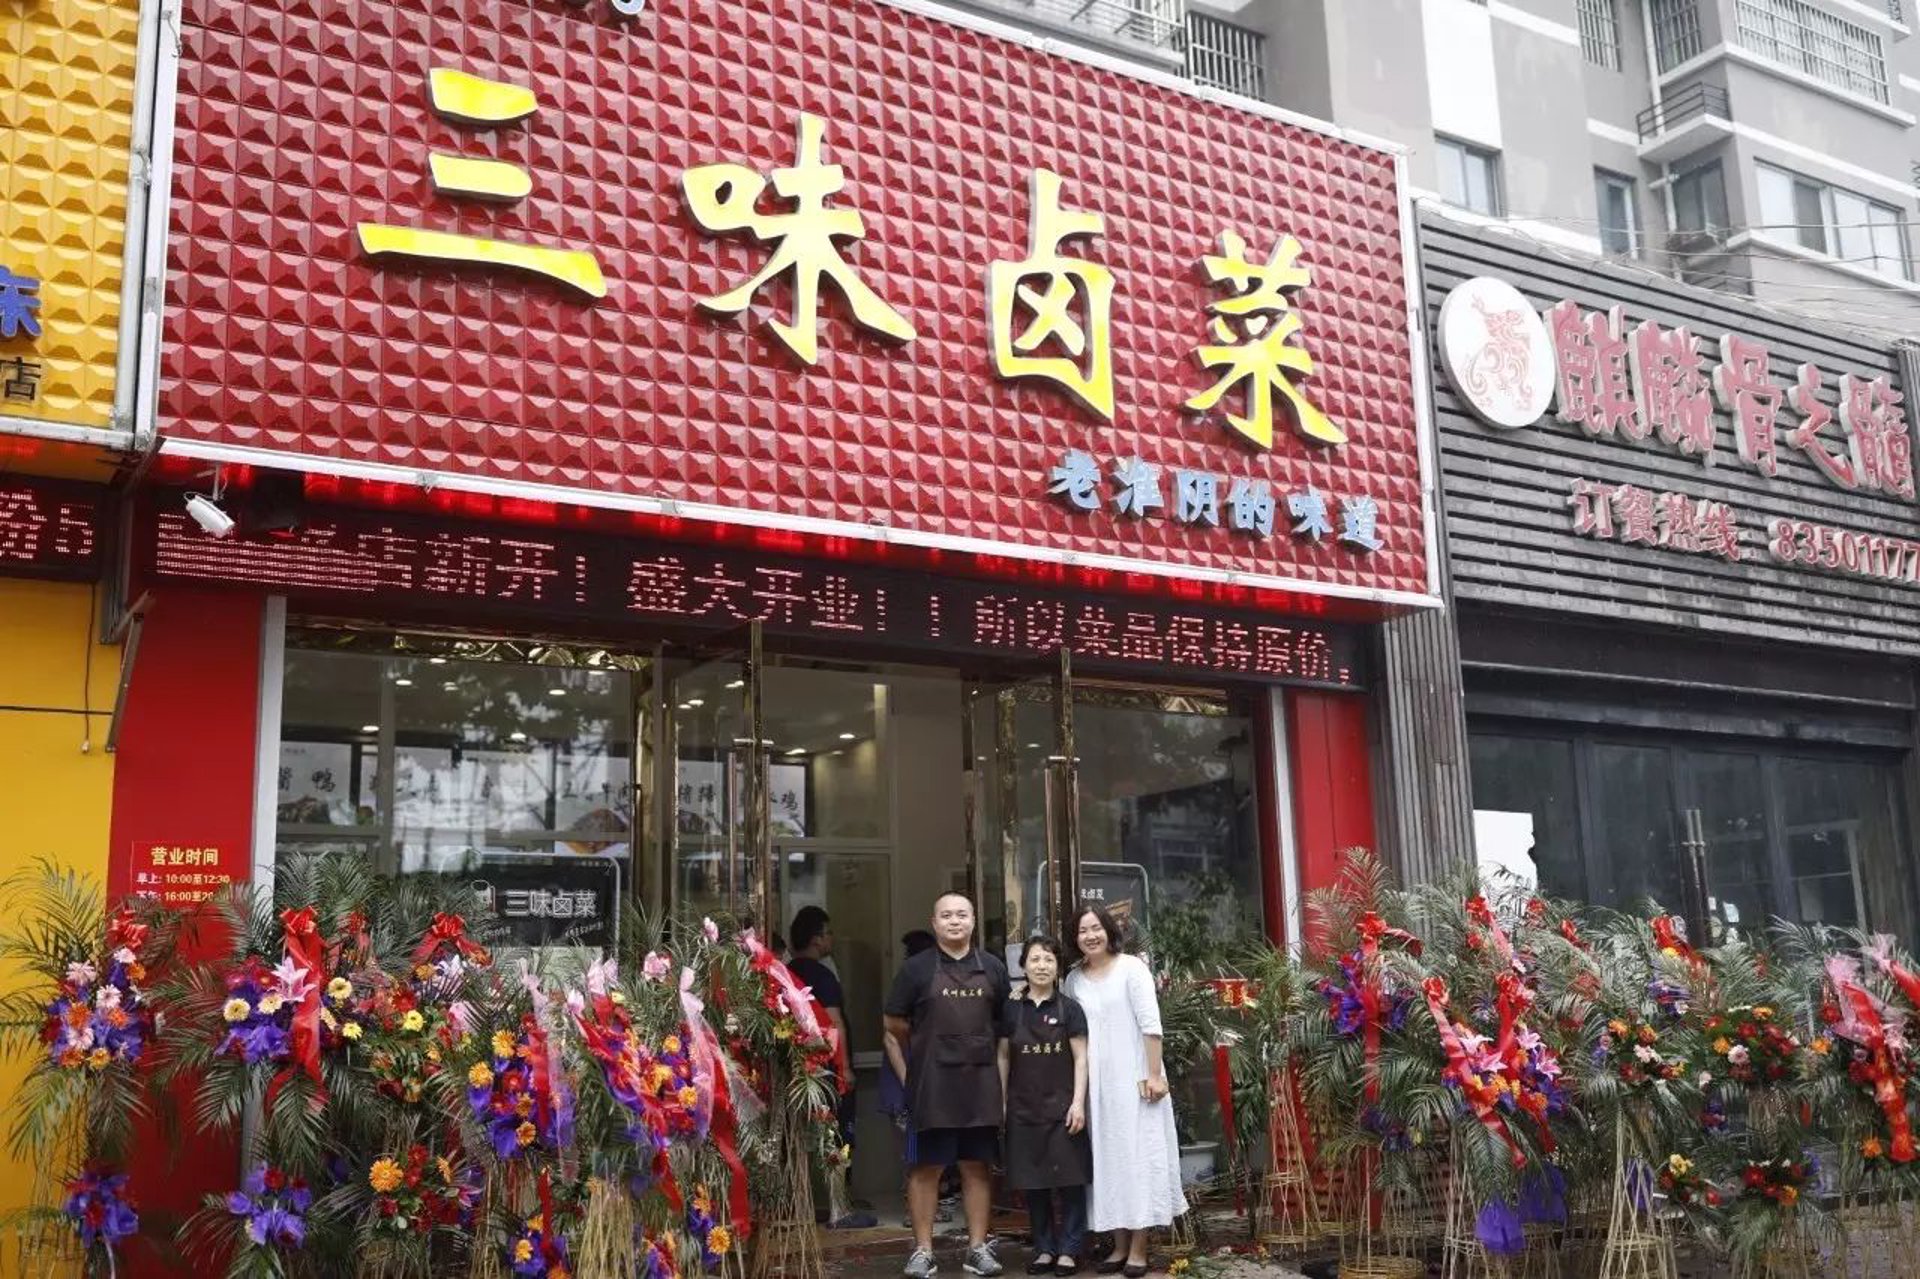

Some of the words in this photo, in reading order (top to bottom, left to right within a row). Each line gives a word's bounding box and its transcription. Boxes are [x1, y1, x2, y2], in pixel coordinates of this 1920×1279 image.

[357, 66, 1349, 450] 三味卤菜
[1046, 447, 1385, 551] 老淮阴的味道
[151, 846, 219, 866] 营业时间
[505, 889, 597, 918] 三味卤菜
